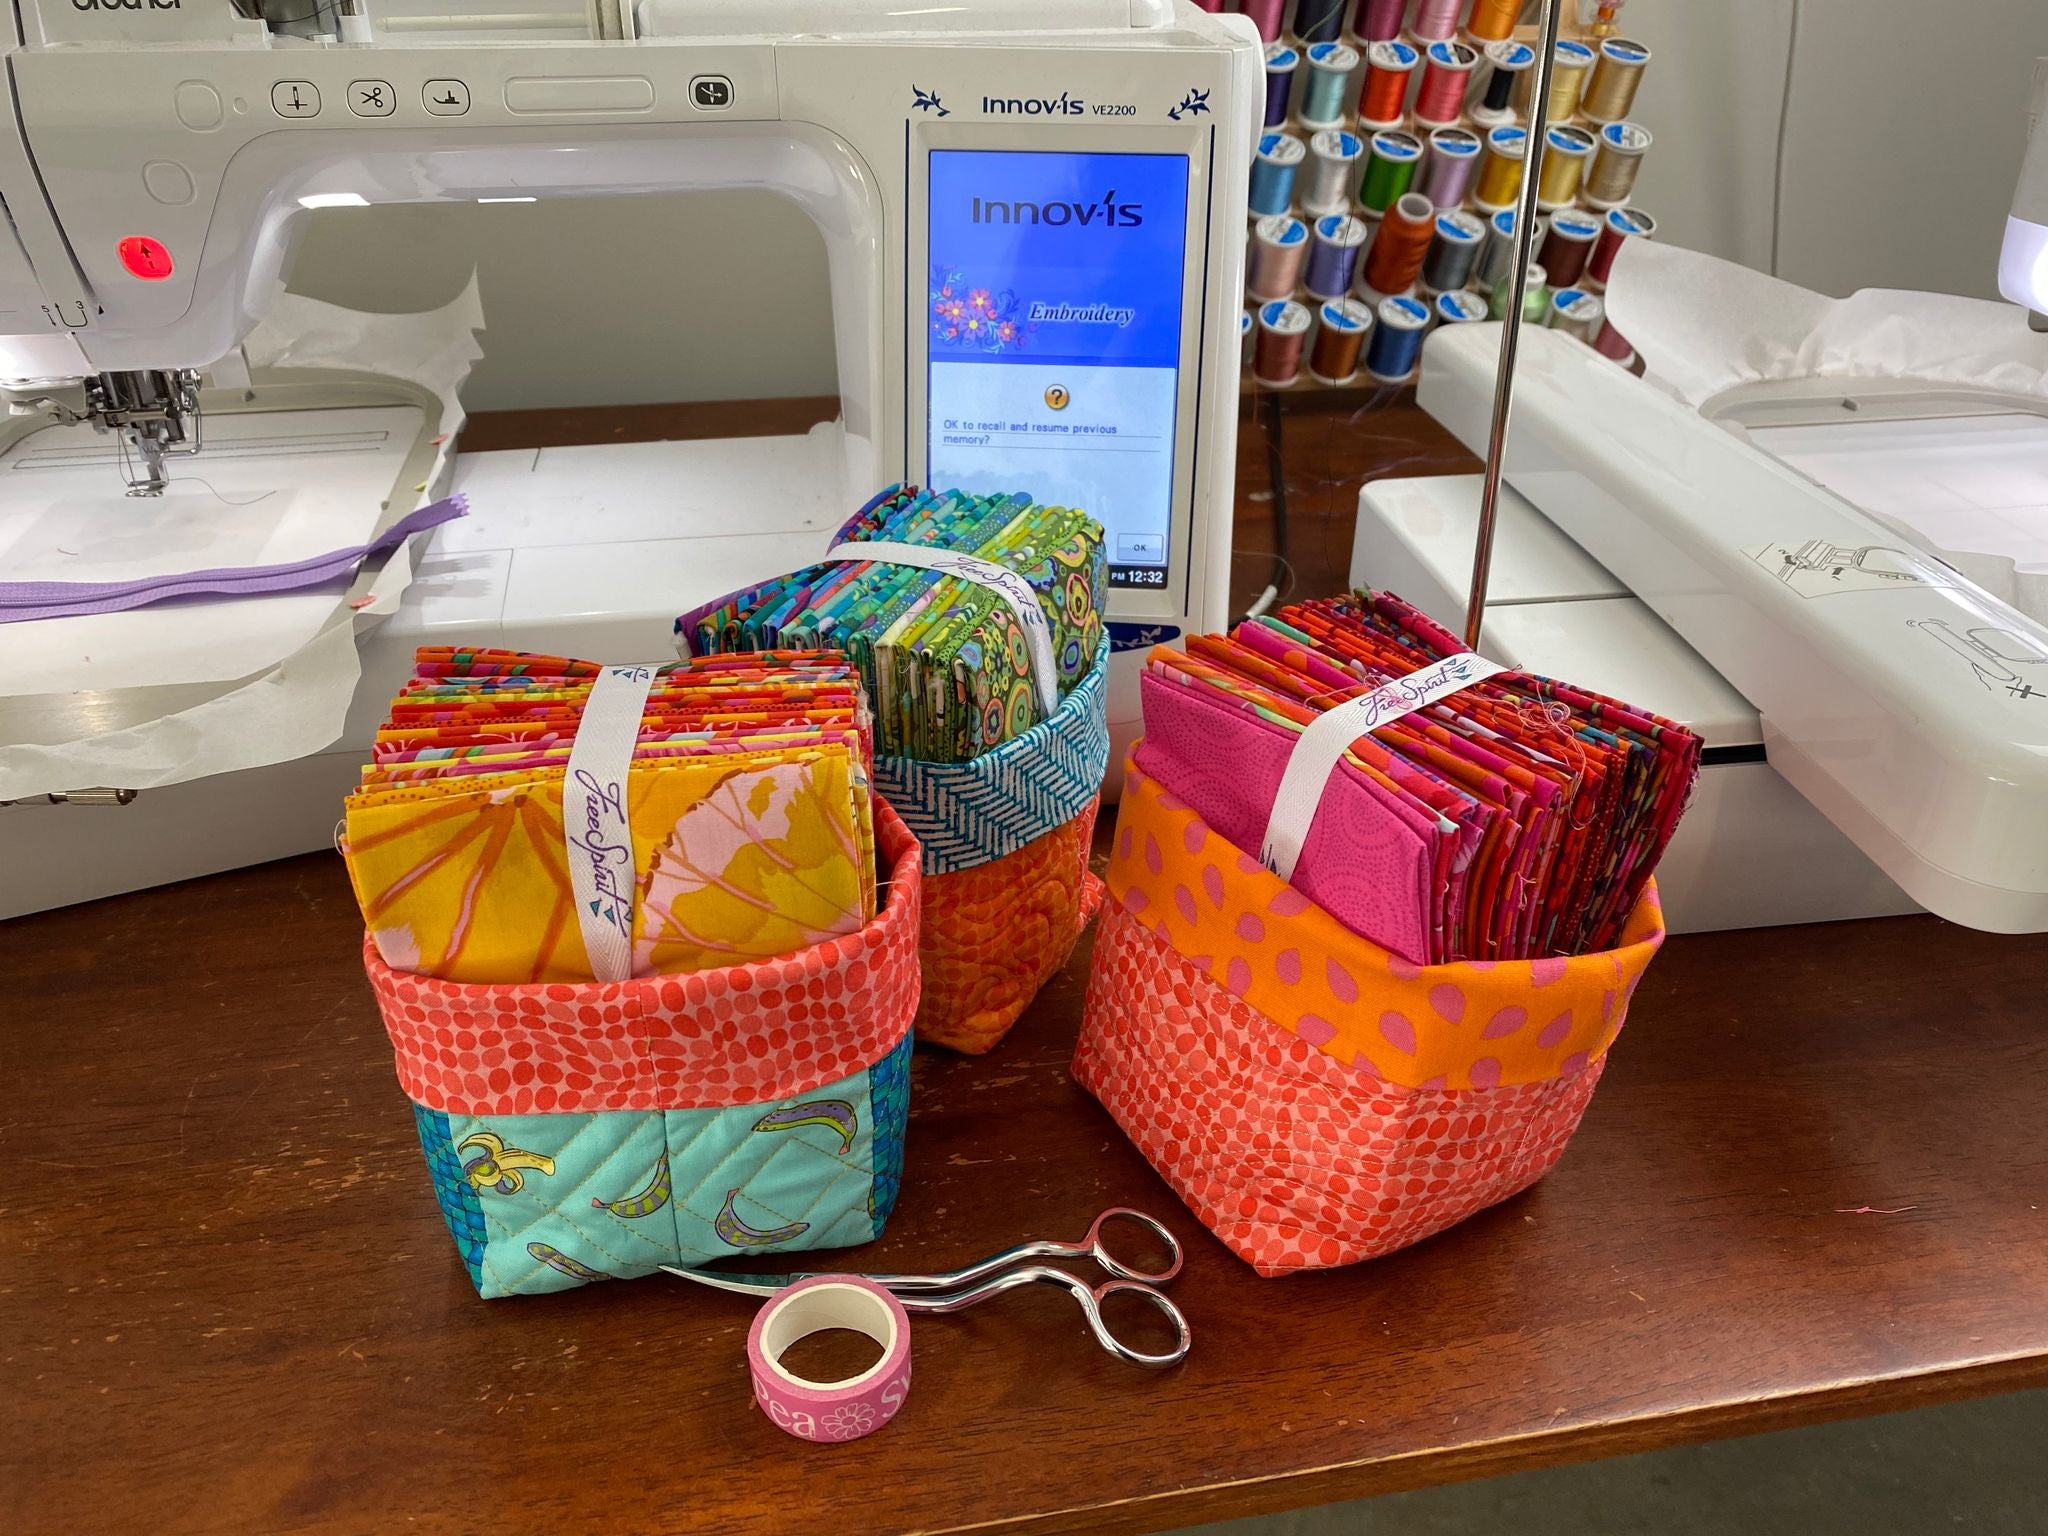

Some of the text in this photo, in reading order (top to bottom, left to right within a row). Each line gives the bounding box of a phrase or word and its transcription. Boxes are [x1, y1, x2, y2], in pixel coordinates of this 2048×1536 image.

[1092, 104, 1136, 116] VE2200
[1029, 302, 1134, 327] Embroidery
[943, 419, 1118, 435] OK to recall and resume previous
[943, 434, 990, 446] memory?
[1133, 544, 1147, 552] OK
[1111, 570, 1163, 583] PM 12:32
